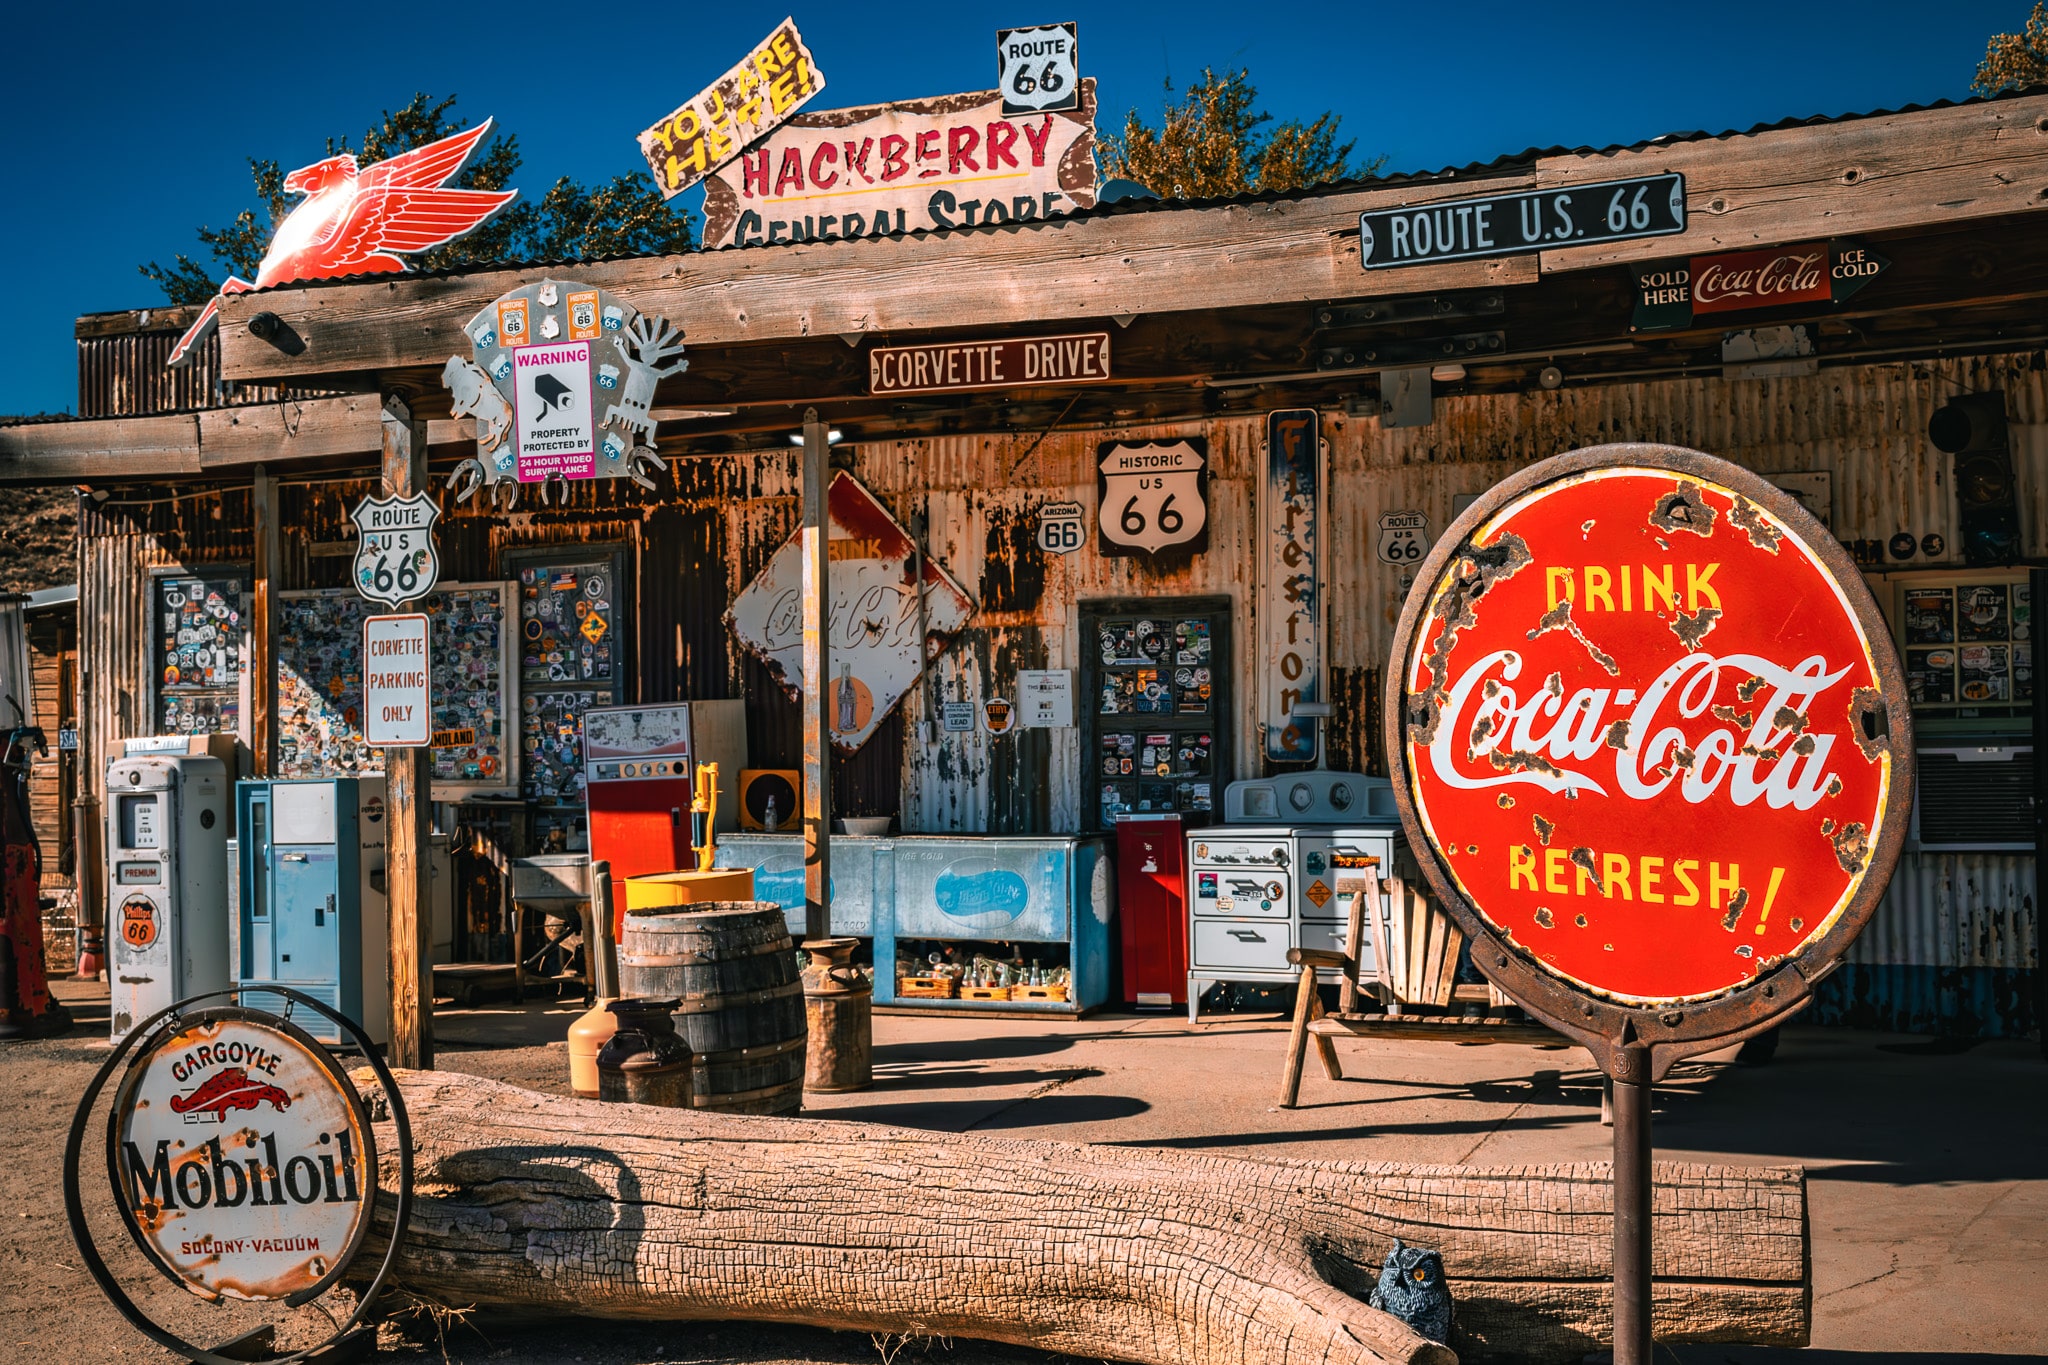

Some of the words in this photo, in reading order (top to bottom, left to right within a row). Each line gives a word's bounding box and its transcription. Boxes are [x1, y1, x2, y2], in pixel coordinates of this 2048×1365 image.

[1009, 38, 1066, 59] ROUTE
[1012, 61, 1063, 97] 66
[651, 90, 725, 151] YOU
[738, 32, 796, 100] ARE
[743, 113, 1056, 199] HACKBERRY
[1391, 204, 1495, 259] ROUTE
[1519, 195, 1584, 243] U.S.
[1607, 184, 1651, 233] 66
[1839, 248, 1866, 265] ICE
[1640, 269, 1690, 290] SOLD
[1694, 251, 1824, 303] Coca-Cola
[1831, 261, 1880, 280] COLD
[569, 292, 595, 303] HISTORIC
[1643, 285, 1690, 306] HERE
[507, 322, 520, 332] 66
[577, 315, 591, 325] 66
[604, 316, 619, 329] 66
[480, 333, 494, 348] 66
[575, 330, 595, 339] ROUTE
[517, 348, 588, 368] WARNING
[881, 345, 1005, 388] CORVETTE
[1025, 338, 1098, 379] DRIVE
[498, 364, 511, 380] 66
[599, 375, 613, 388] 66
[530, 427, 580, 440] PROPERTY
[523, 440, 575, 452] PROTECTED
[577, 439, 590, 449] BY
[603, 444, 616, 458] 66
[499, 458, 512, 470] 66
[520, 458, 532, 468] 24
[533, 456, 562, 467] HOUR
[562, 454, 593, 465] VIDEO
[1120, 454, 1183, 469] HISTORIC
[371, 507, 421, 527] ROUTE
[1044, 507, 1078, 516] ARIZONA
[1120, 493, 1184, 536] 66
[1387, 516, 1420, 528] ROUTE
[1045, 521, 1078, 548] 66
[828, 538, 882, 561] RINK
[1387, 539, 1420, 561] 66
[373, 553, 418, 593] 66
[1276, 417, 1309, 751] Firestone
[1546, 562, 1722, 613] DRINK
[371, 638, 424, 657] CORVETTE
[370, 671, 425, 690] PARKING
[382, 705, 413, 723] ONLY
[1429, 649, 1855, 811] Coca-Cola
[125, 868, 157, 878] PREMIUM
[125, 905, 151, 921] Phillips
[129, 922, 149, 941] 66
[171, 1041, 282, 1082] GARGOYLE
[122, 1128, 361, 1212] Mobiloil
